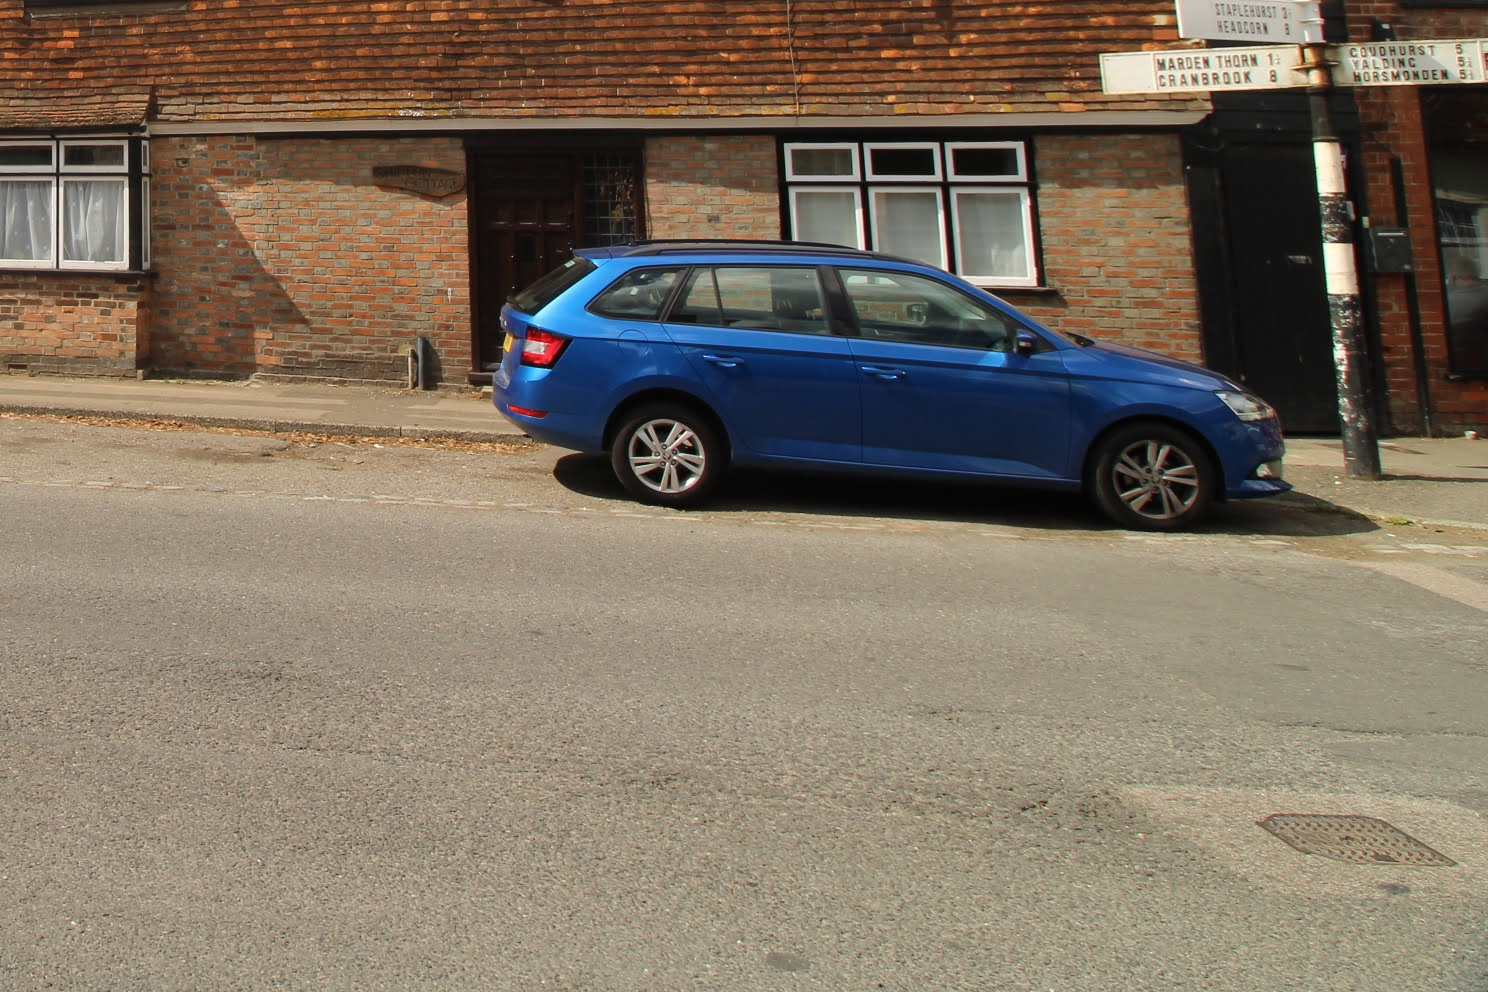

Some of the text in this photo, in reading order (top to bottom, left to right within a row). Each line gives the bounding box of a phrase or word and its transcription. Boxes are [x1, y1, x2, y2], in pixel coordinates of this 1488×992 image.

[1214, 3, 1277, 19] STAPLEHURST
[1216, 20, 1269, 35] HEADCORN
[1349, 44, 1463, 58] GOUDHURST 5
[1157, 55, 1210, 71] MARDEN
[1217, 53, 1258, 68] THORN
[1351, 57, 1416, 69] YALDING
[1157, 70, 1278, 88] CRANBROOK 8
[1353, 69, 1449, 83] HORSMONDEN
